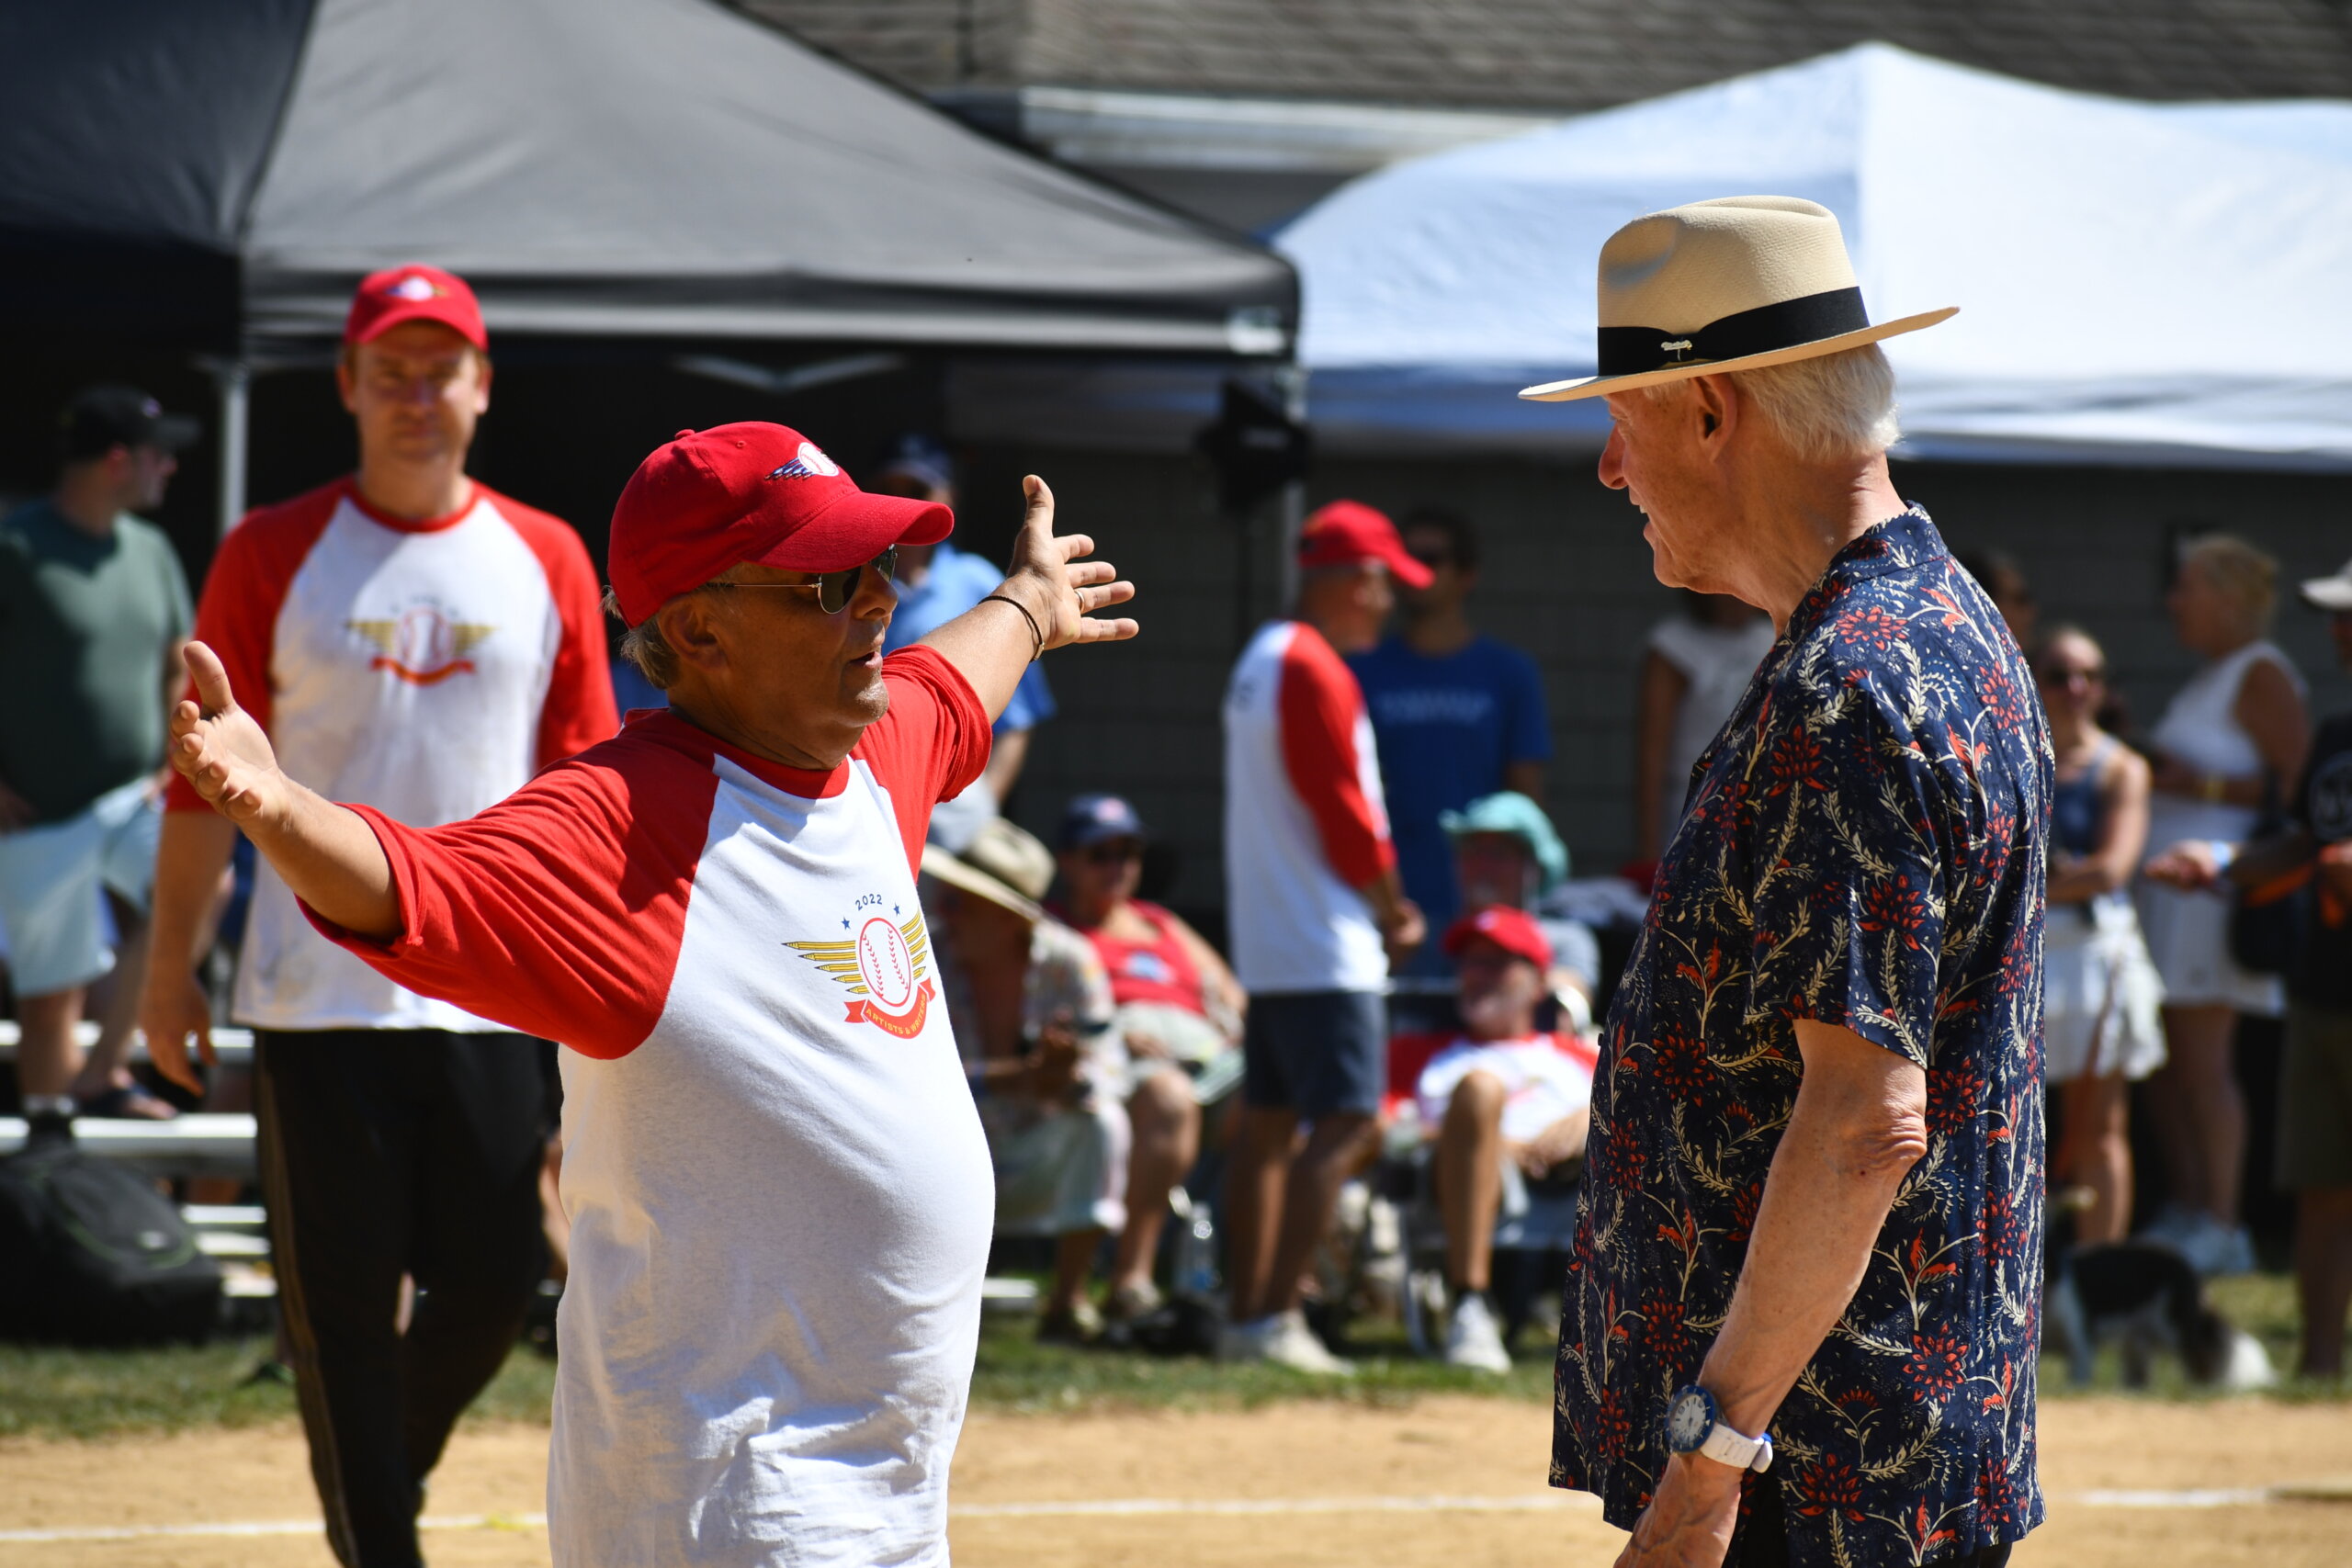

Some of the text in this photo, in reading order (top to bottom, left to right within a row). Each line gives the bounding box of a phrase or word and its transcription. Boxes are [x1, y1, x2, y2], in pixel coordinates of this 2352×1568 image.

[855, 893, 883, 911] 2022
[865, 993, 926, 1035] ARTISTS & WRITERS
